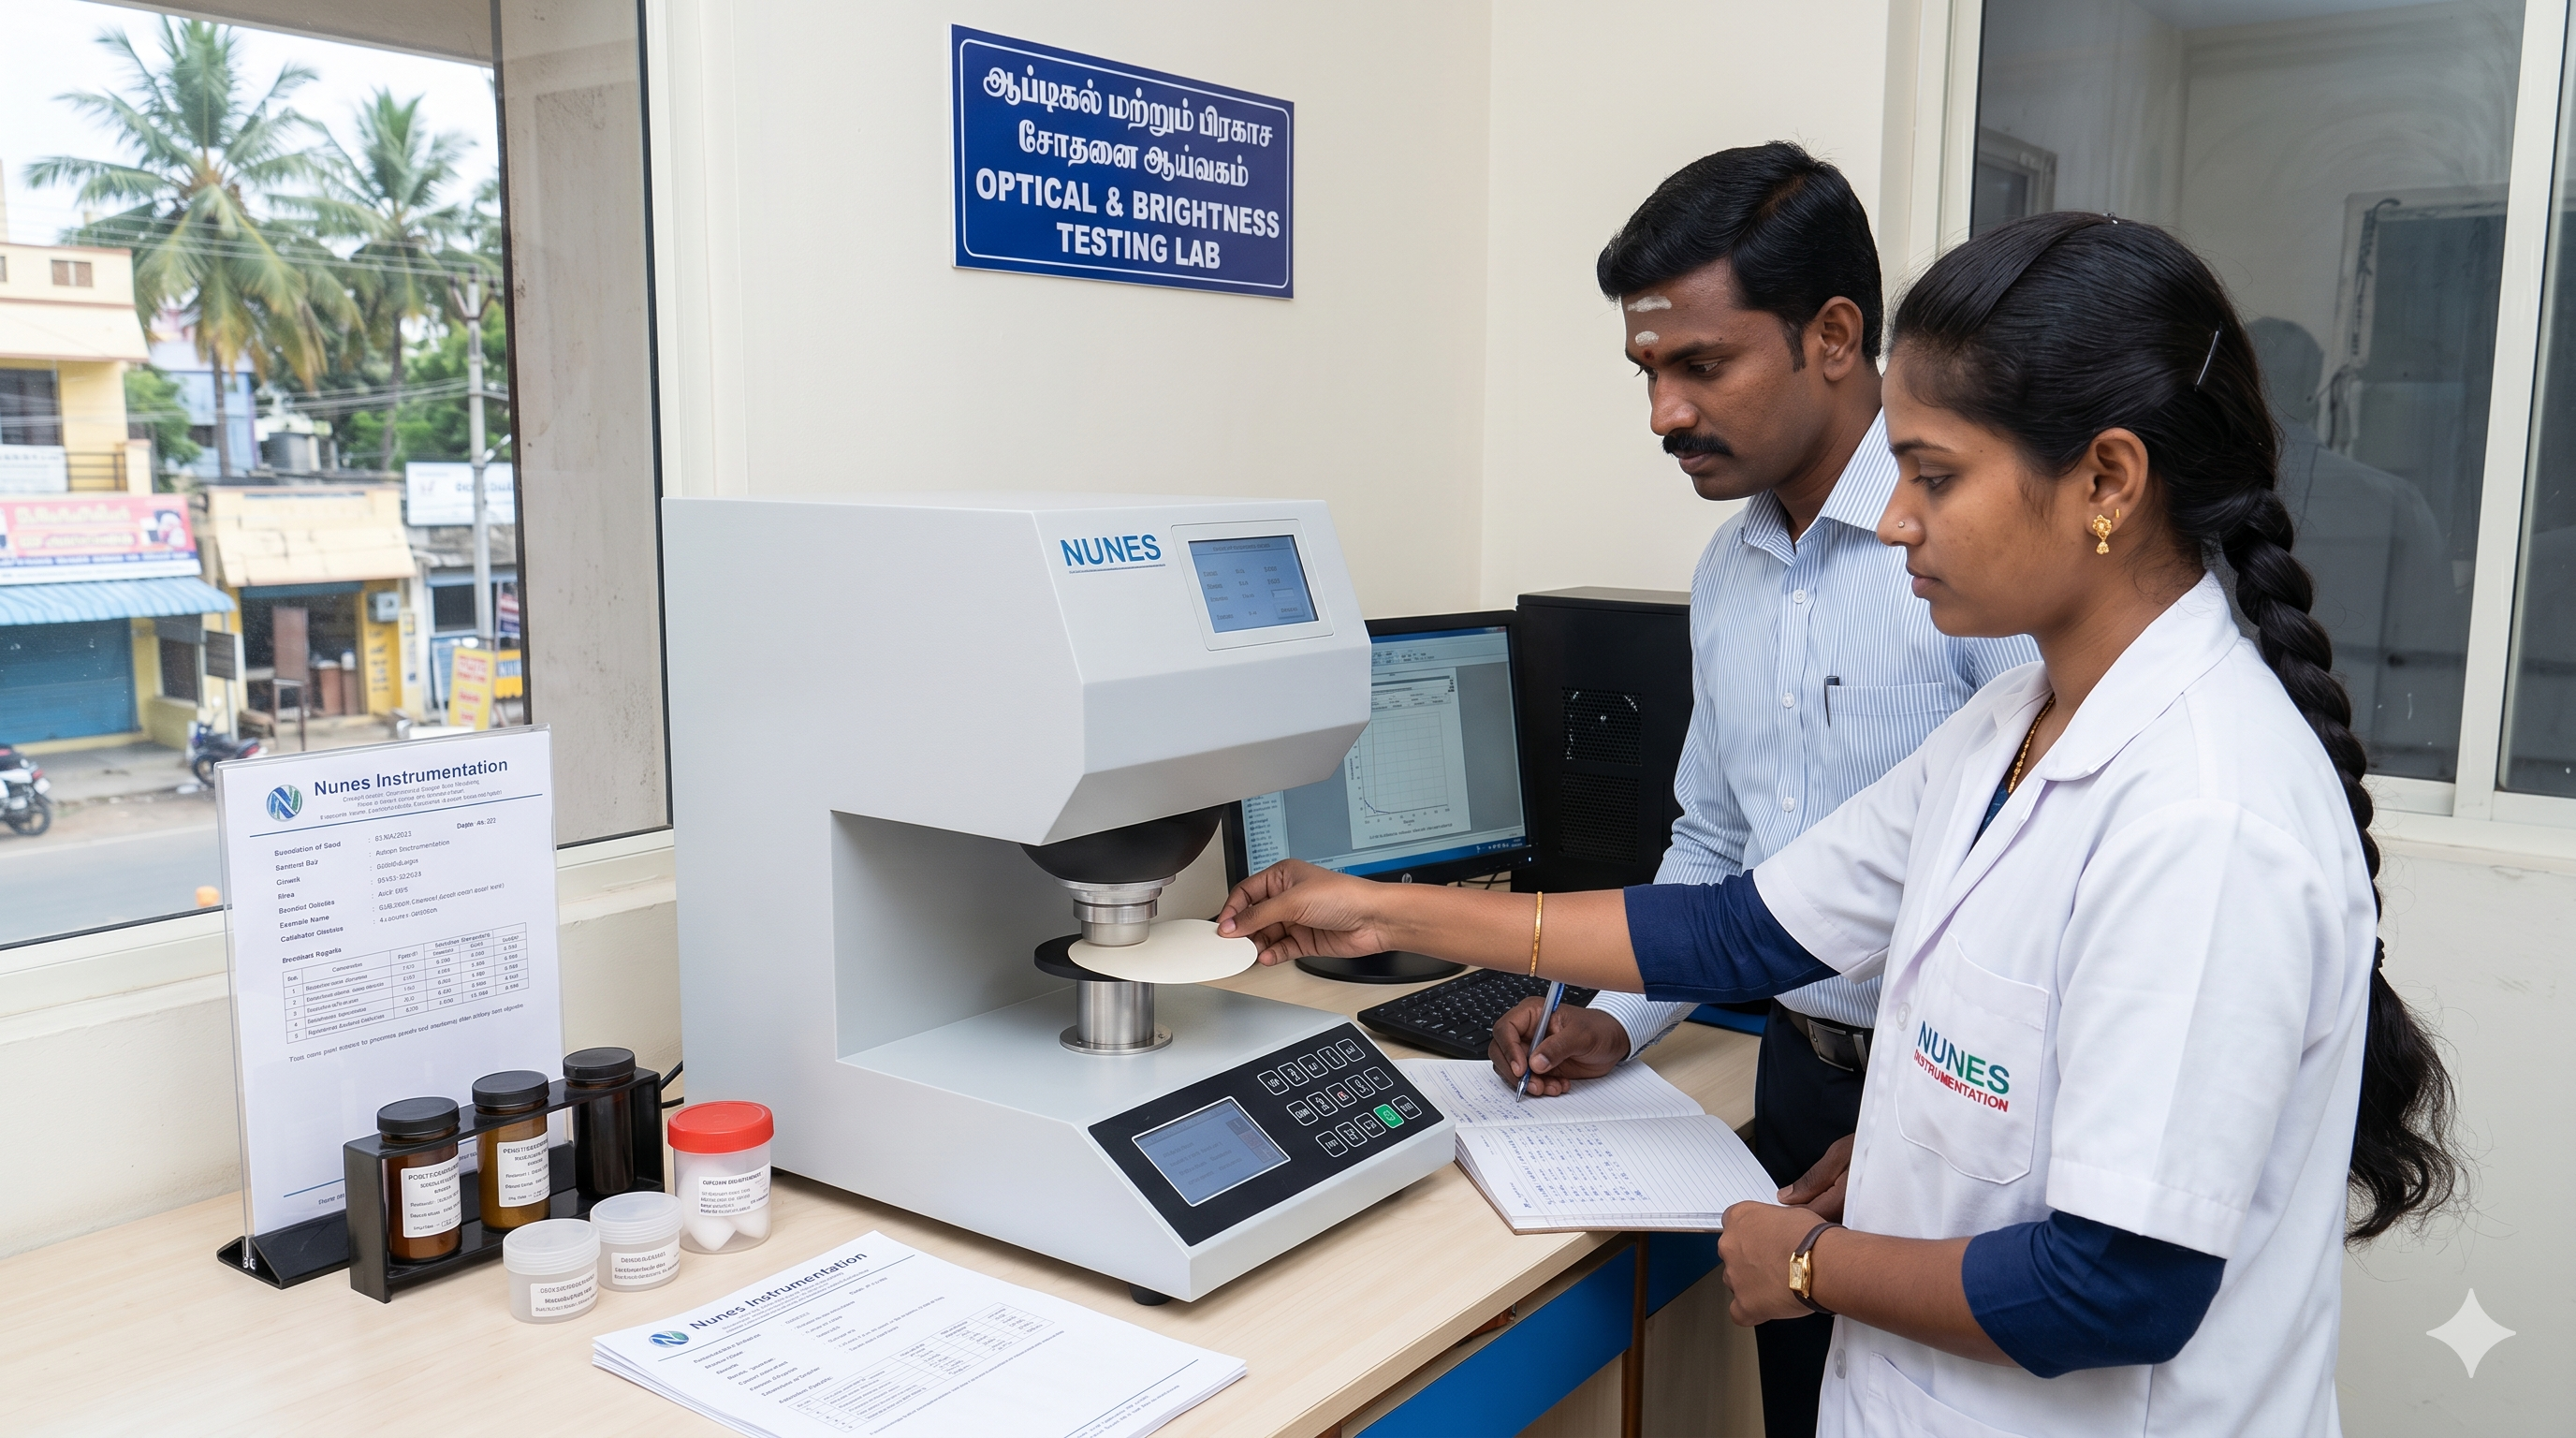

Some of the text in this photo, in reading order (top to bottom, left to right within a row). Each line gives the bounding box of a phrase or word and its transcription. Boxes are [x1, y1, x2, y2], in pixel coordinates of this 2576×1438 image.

[983, 64, 1273, 147] ஆப்டிகல் மற்றும் பிரகாச
[1018, 119, 1249, 187] சோதனை ஆய்வகம்
[975, 168, 1280, 239] OPTICAL & BRIGHTNESS
[1056, 222, 1221, 269] TESTING LAB
[1060, 534, 1162, 567] NUNES
[315, 775, 371, 797] Nunes
[376, 759, 508, 788] Instrumentation
[1913, 1049, 2009, 1112] INSTRUMENTATION
[1918, 1020, 2010, 1094] NUNES
[688, 1304, 747, 1330] Nunes
[744, 1252, 869, 1309] Instrumentation
